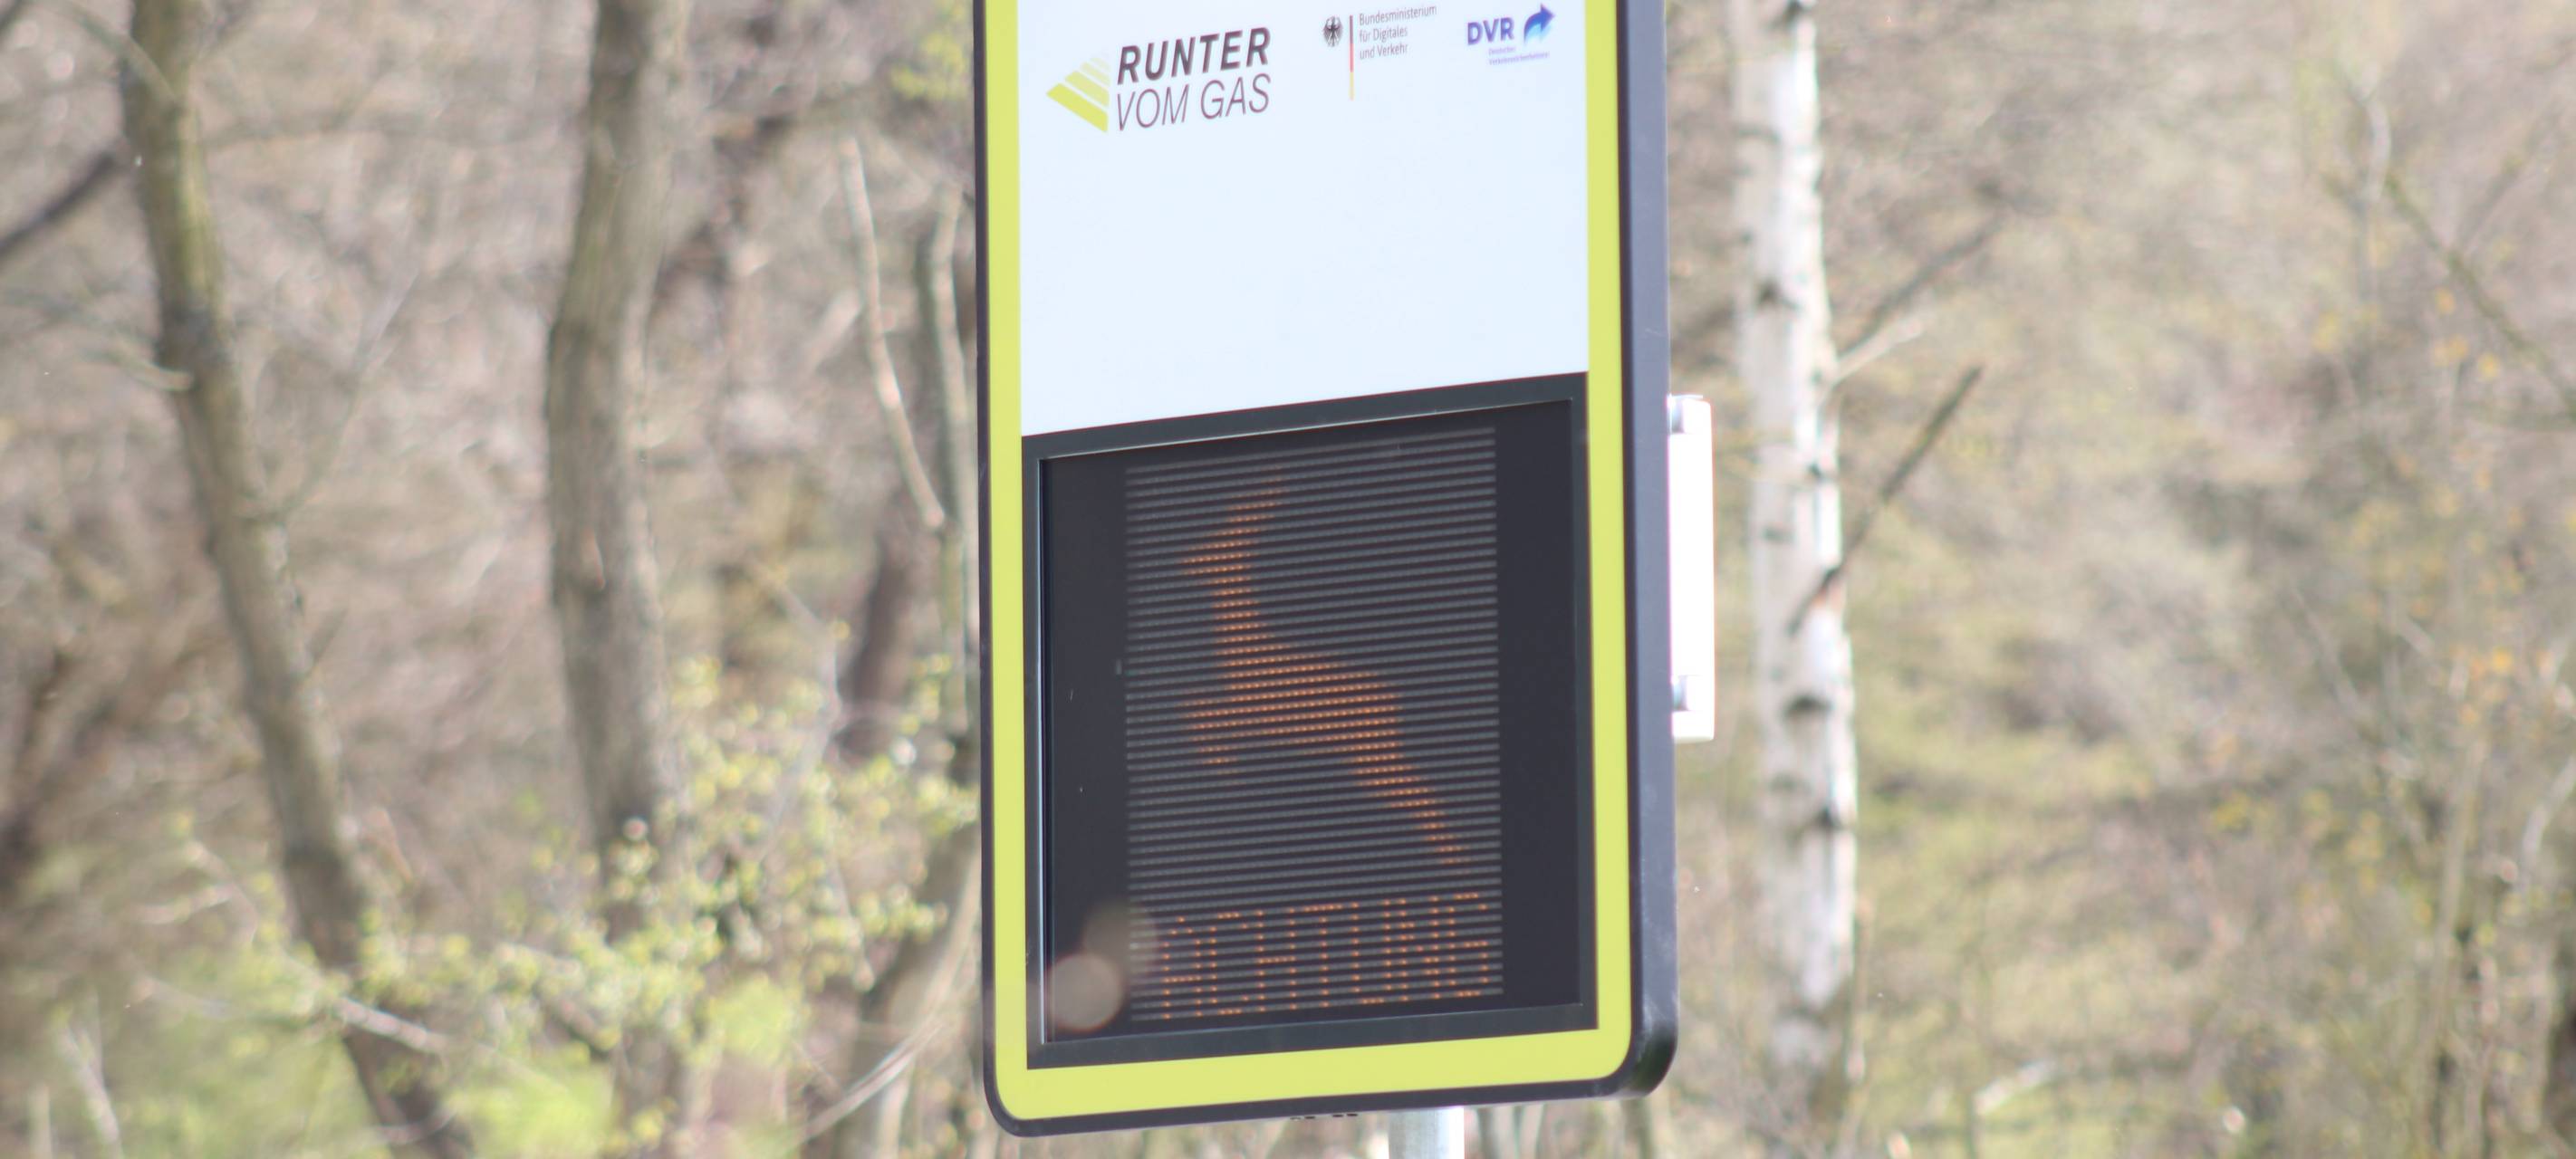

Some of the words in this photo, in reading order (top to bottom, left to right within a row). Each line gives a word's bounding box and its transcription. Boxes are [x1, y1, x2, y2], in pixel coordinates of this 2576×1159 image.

[1359, 5, 1437, 25] Bundesministerium
[1359, 29, 1370, 43] für
[1373, 26, 1408, 43] Digitales
[1467, 17, 1514, 45] DVR
[1117, 27, 1270, 85] RUNTER
[1360, 45, 1375, 60] und
[1377, 43, 1408, 57] Verkehr
[1117, 84, 1189, 131] VOM
[1200, 73, 1272, 120] GAS
[1161, 892, 1490, 1020] ACHTUNG
